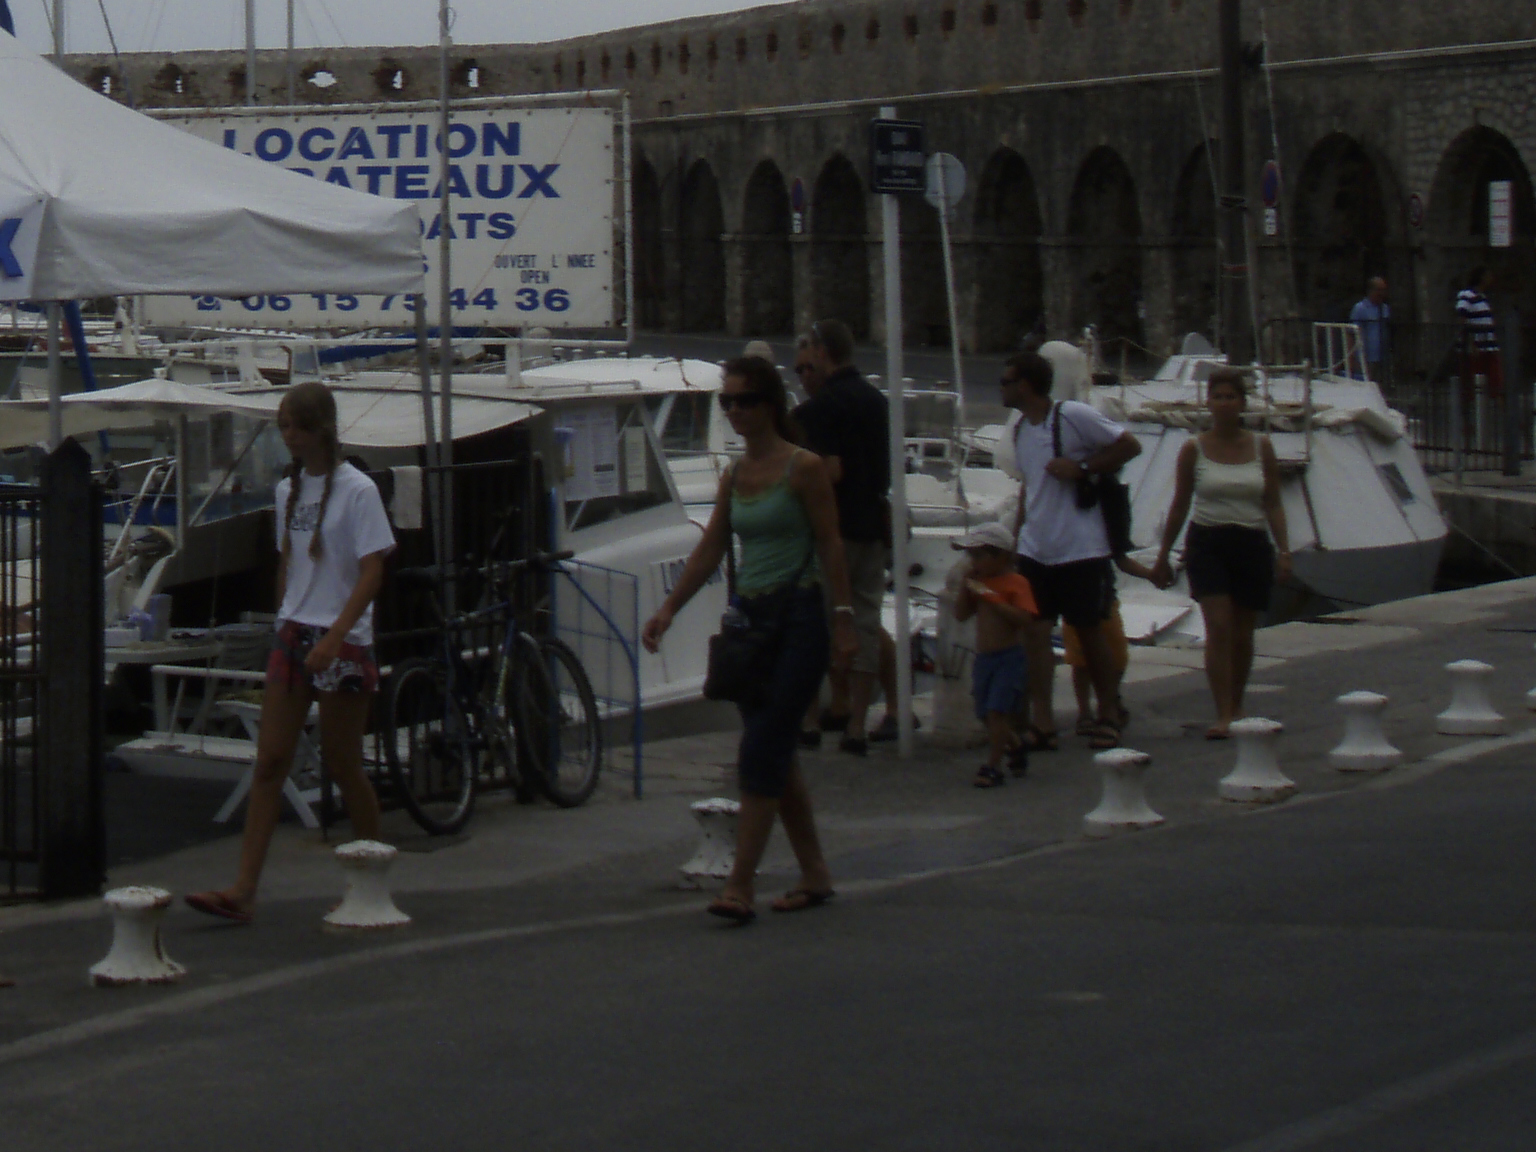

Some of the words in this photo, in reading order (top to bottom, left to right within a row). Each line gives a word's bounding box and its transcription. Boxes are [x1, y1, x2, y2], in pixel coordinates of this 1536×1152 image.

[223, 121, 520, 163] LOCATION
[285, 163, 560, 199] ATEAUX
[419, 212, 516, 240] ATS
[515, 288, 570, 311] 36
